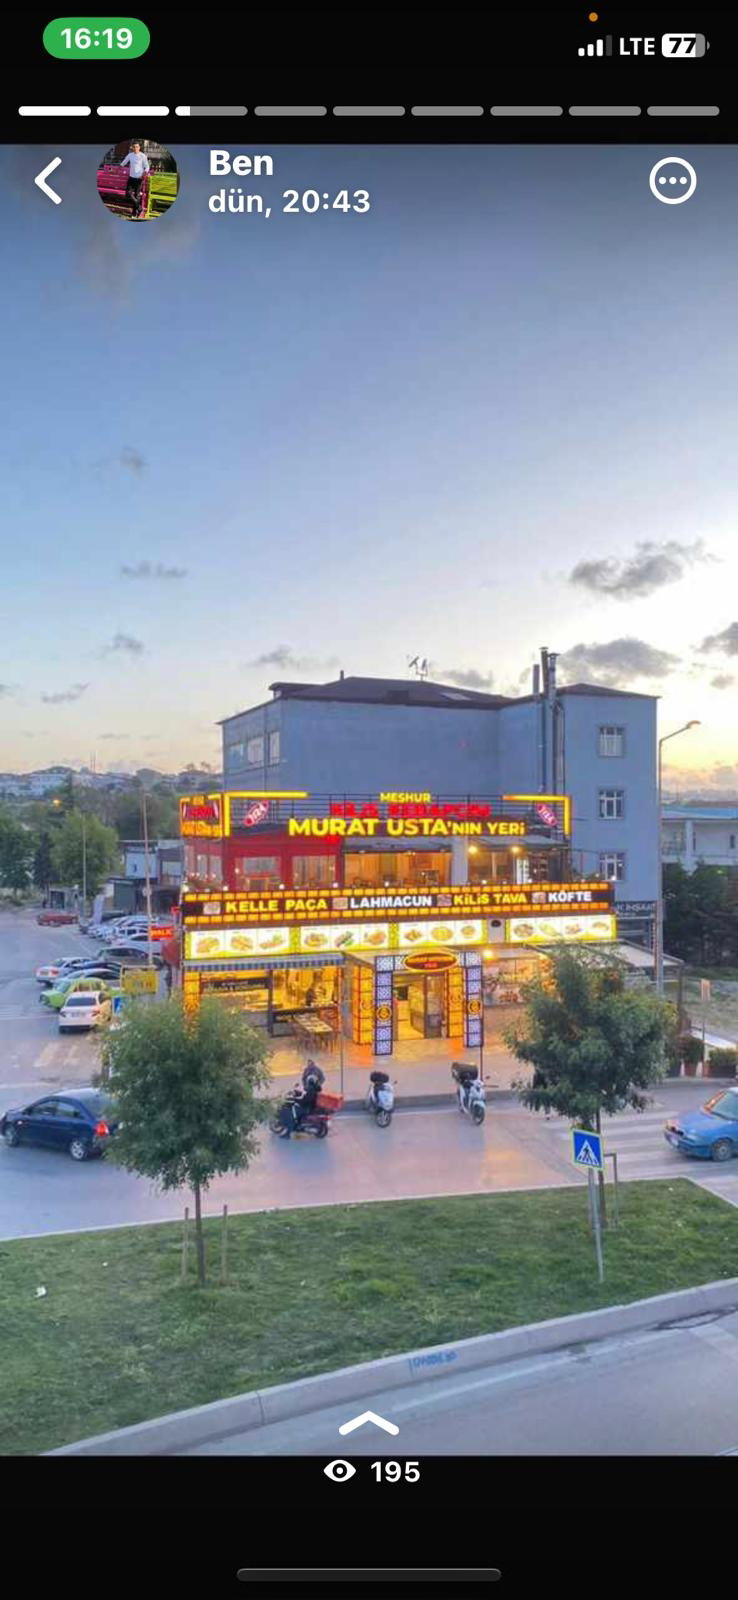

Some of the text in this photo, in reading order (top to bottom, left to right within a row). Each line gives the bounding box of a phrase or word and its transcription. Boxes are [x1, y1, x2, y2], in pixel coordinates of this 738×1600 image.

[288, 817, 379, 837] MURAT
[386, 818, 485, 837] USTA'NIN
[349, 895, 433, 910] LAHMACUN
[494, 892, 528, 905] TAVA
[548, 889, 593, 903] KÖFTE
[225, 899, 279, 914] KELLE
